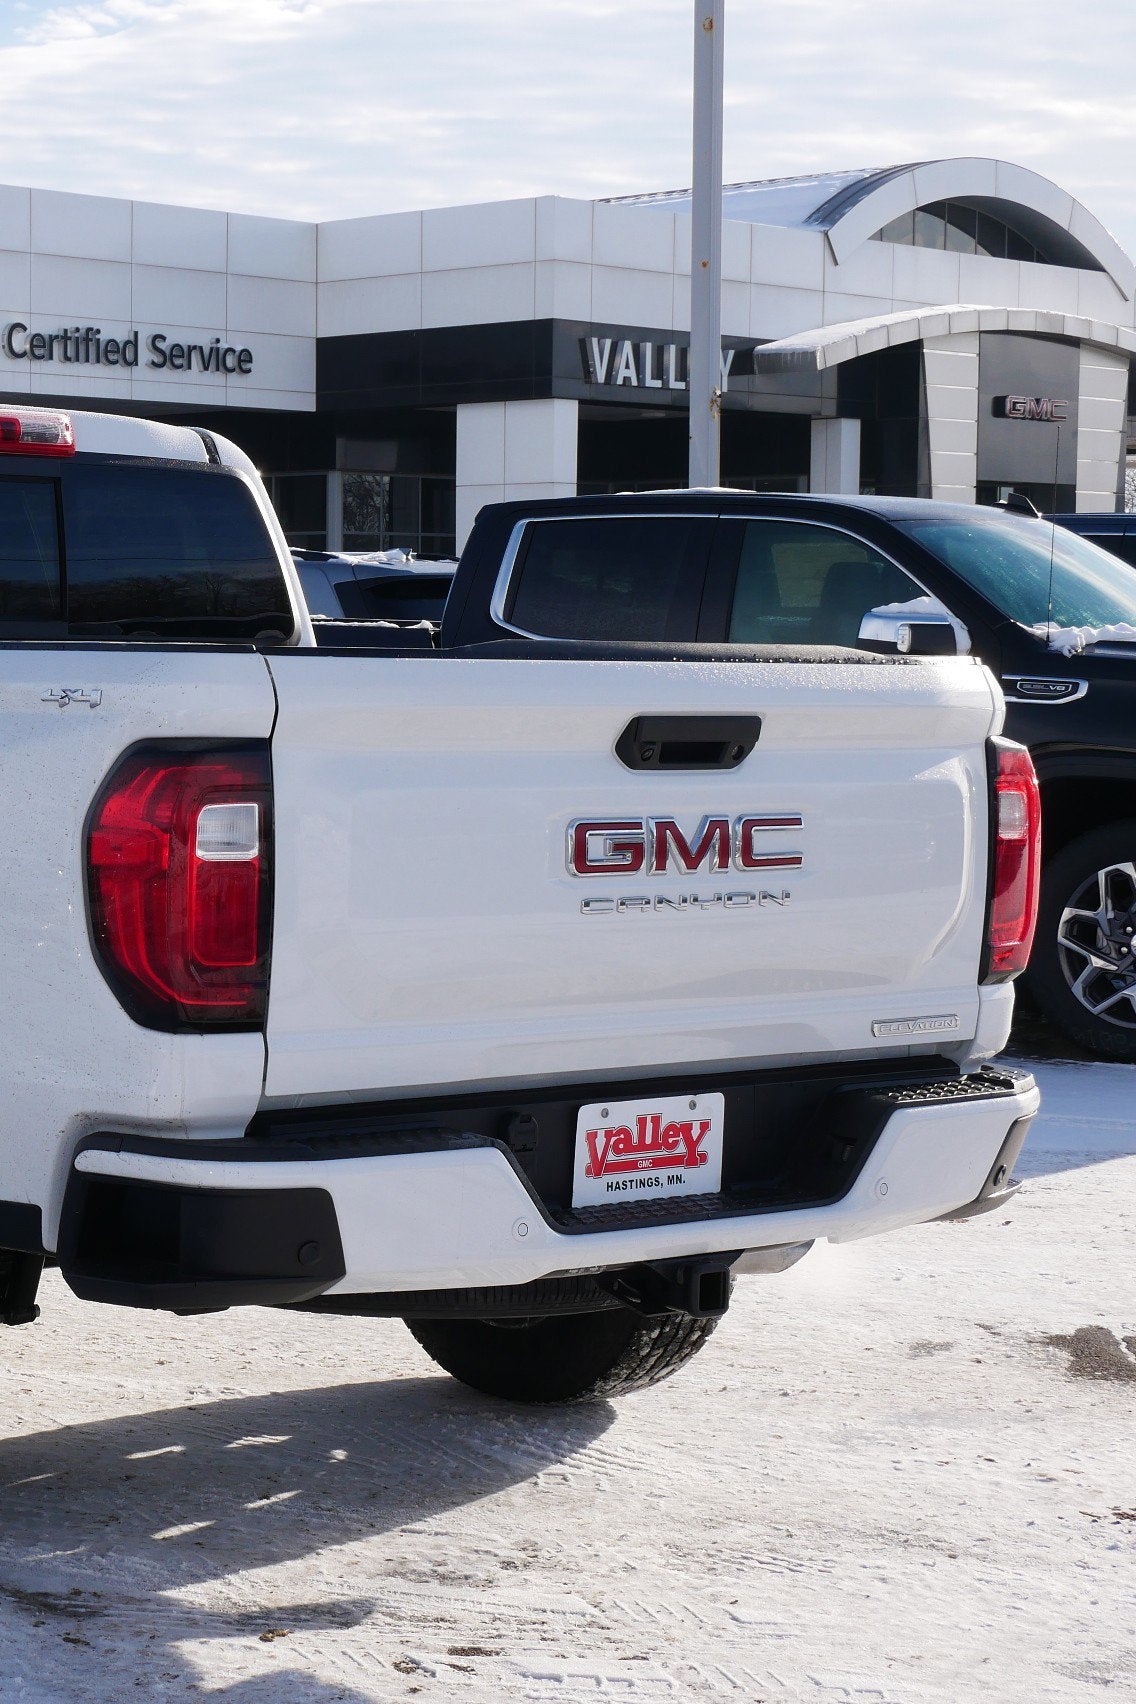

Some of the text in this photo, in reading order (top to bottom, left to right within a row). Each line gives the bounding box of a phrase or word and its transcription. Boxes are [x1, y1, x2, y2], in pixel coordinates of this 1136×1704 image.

[4, 322, 253, 374] Certified Service
[589, 337, 735, 392] VALLY
[1006, 395, 1068, 421] GMC
[565, 812, 804, 878] GMC
[580, 889, 791, 915] CANYON
[637, 1159, 653, 1169] GMC
[606, 1173, 686, 1192] HASTINGS, MN.
